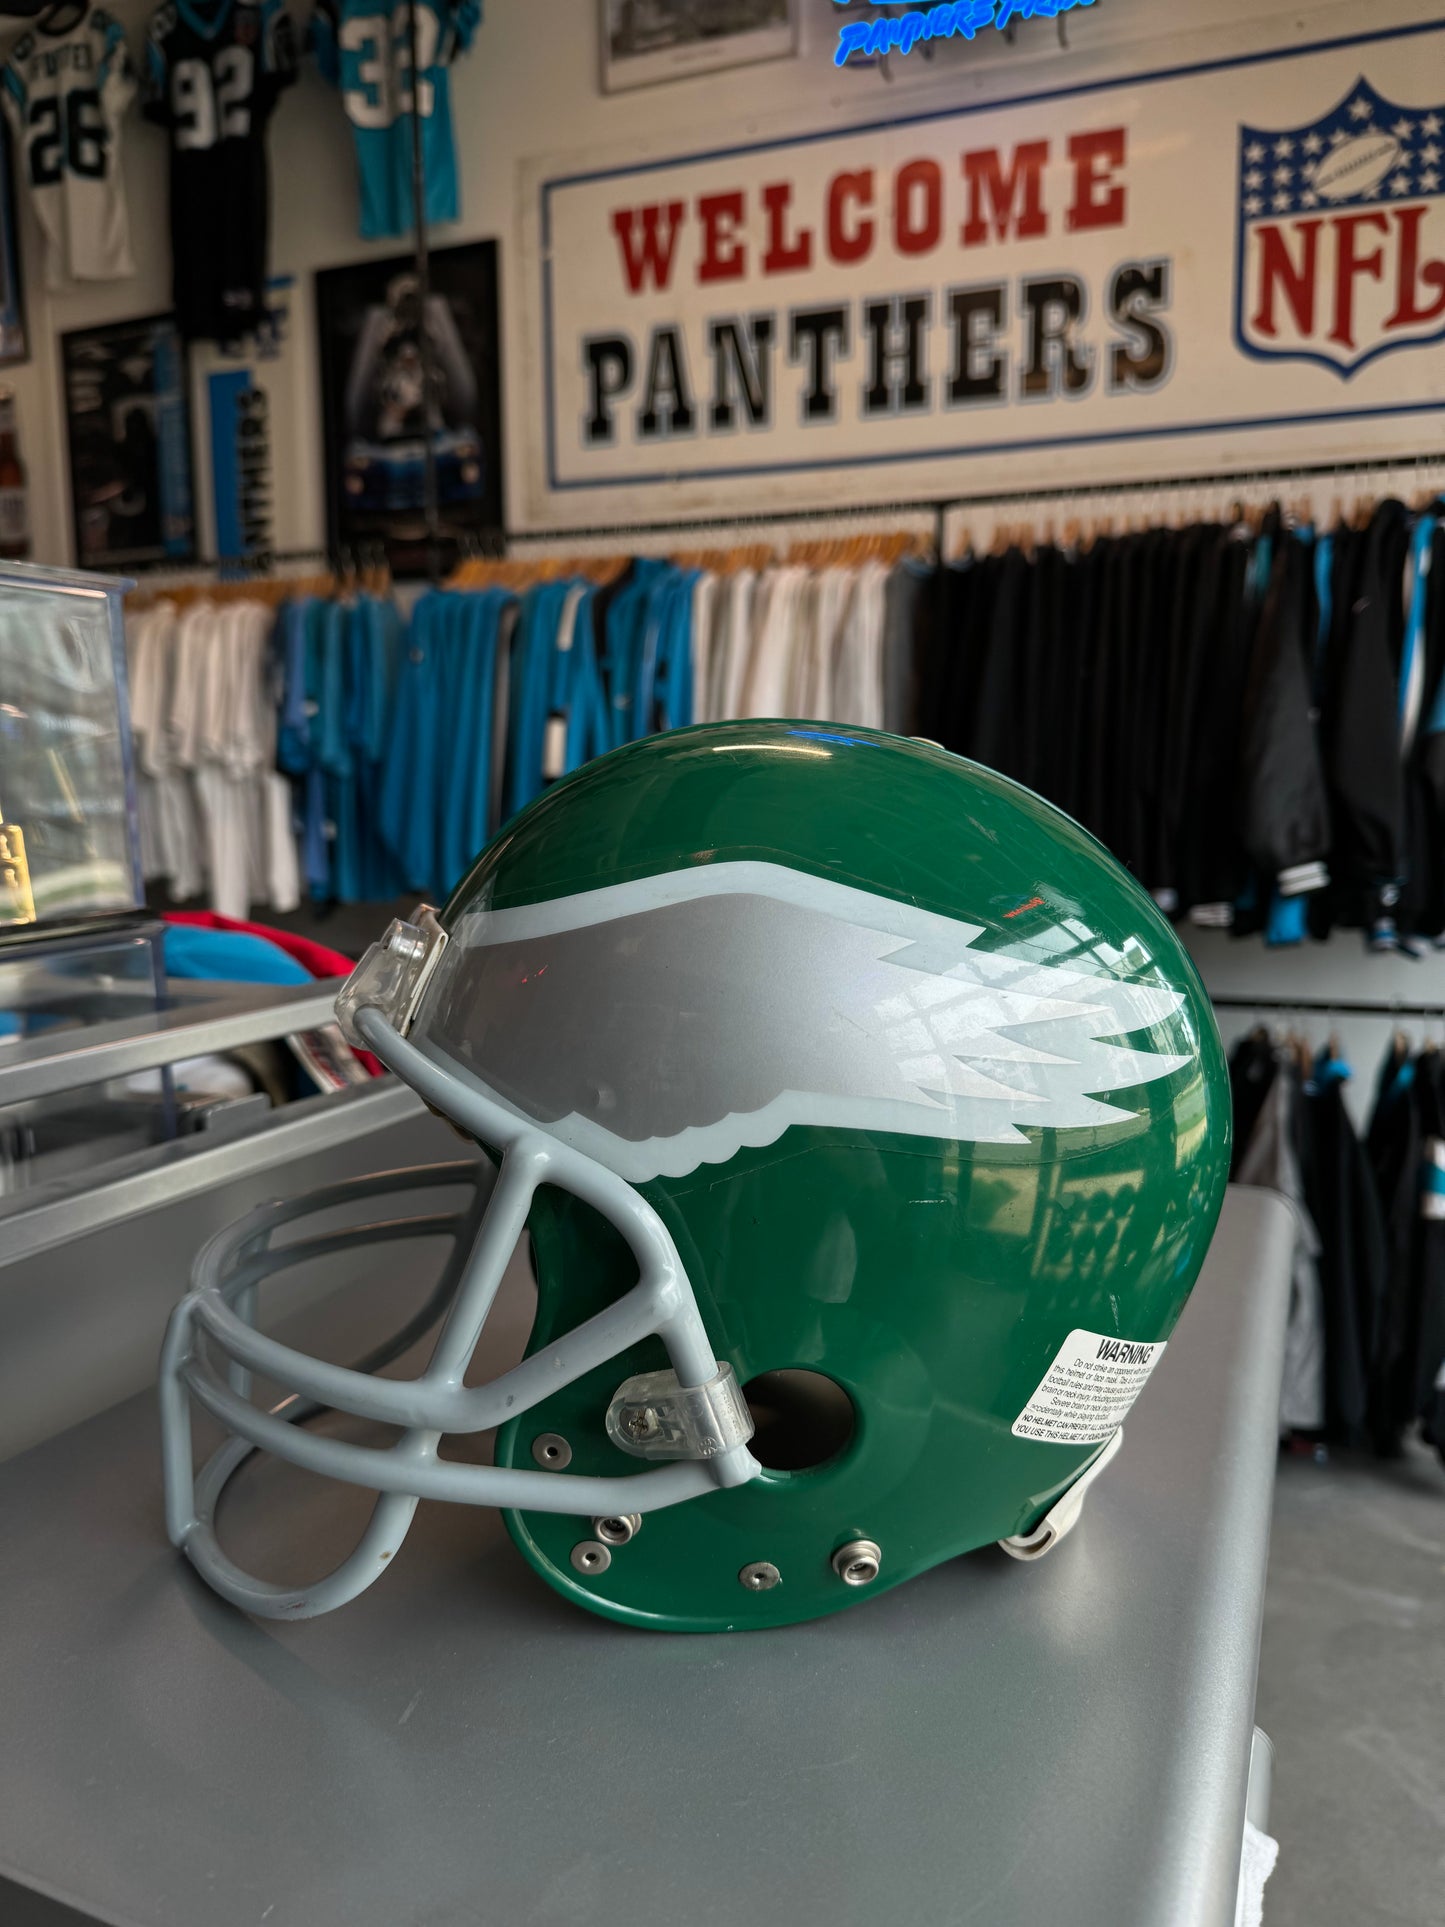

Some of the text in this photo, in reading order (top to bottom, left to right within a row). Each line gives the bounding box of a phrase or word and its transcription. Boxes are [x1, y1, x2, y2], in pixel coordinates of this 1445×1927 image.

[171, 44, 254, 149] 92
[30, 90, 108, 185] 26
[610, 126, 1128, 297] WELCOME
[1250, 204, 1445, 350] NFL
[581, 255, 1173, 449] PANTHERS
[1096, 1339, 1154, 1364] WARNING
[1074, 1358, 1083, 1368] Do
[1084, 1360, 1093, 1369] not
[1053, 1364, 1064, 1374] this
[1066, 1366, 1085, 1379] helmet
[1086, 1372, 1092, 1380] or
[1047, 1374, 1068, 1387] football
[1069, 1378, 1082, 1389] rules
[1041, 1384, 1057, 1396] brain
[1063, 1389, 1076, 1398] neck
[1050, 1397, 1070, 1409] Severe
[1022, 1413, 1033, 1423] NO
[1033, 1416, 1058, 1428] HELMET
[1056, 1420, 1069, 1429] CAN
[1016, 1424, 1031, 1434] YOU
[1030, 1426, 1044, 1437] USE
[1044, 1428, 1059, 1439] THIS
[1058, 1430, 1081, 1440] HELMET
